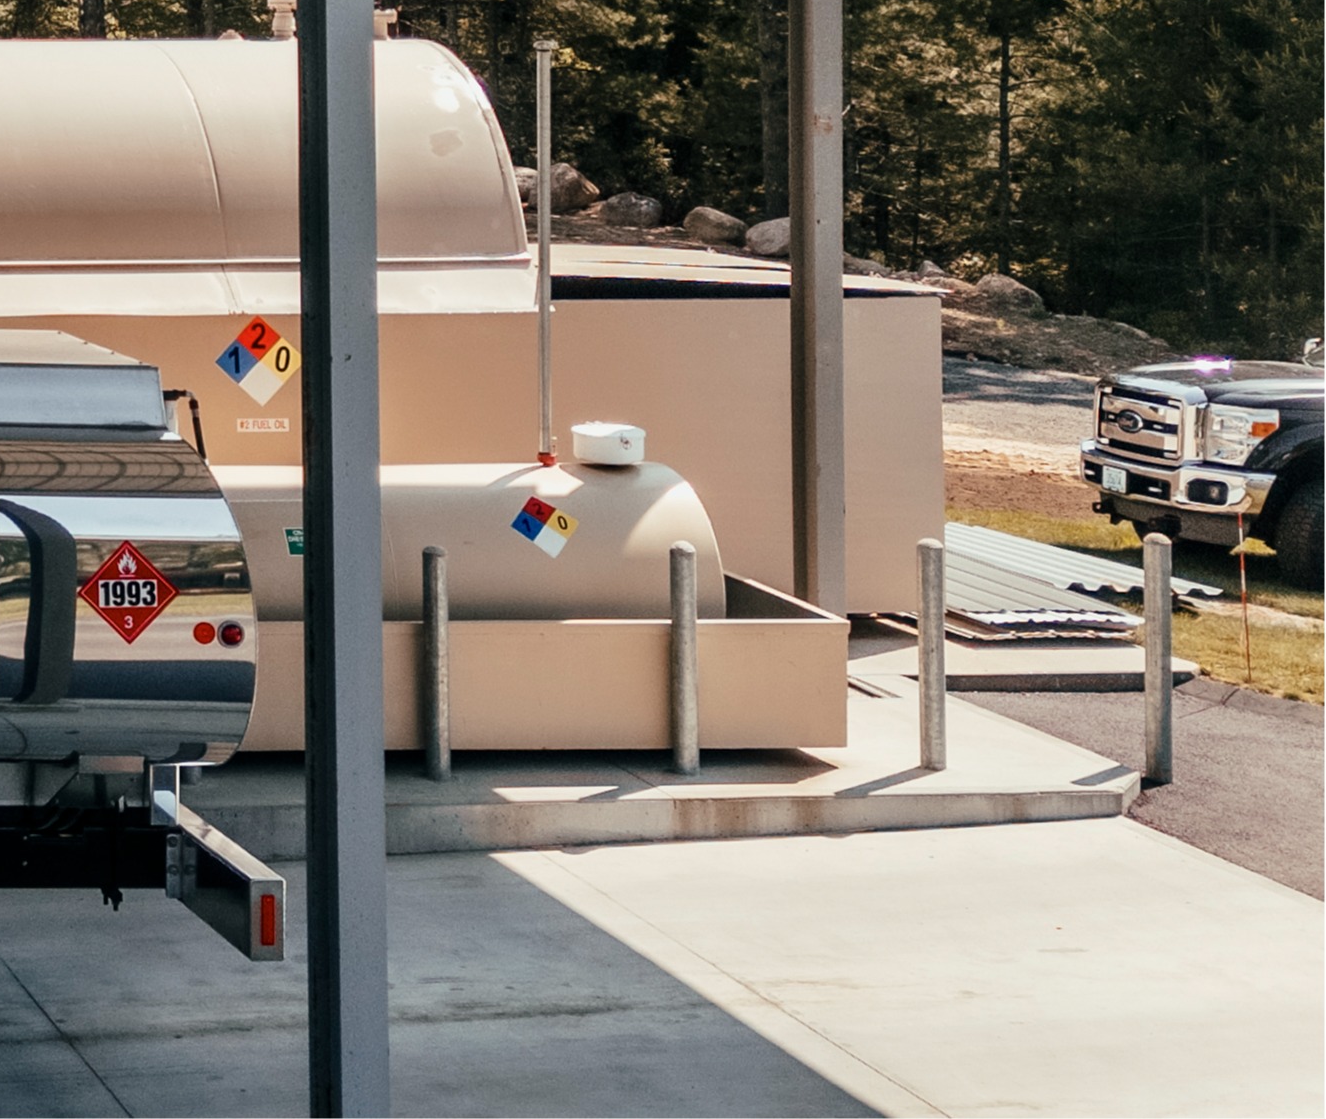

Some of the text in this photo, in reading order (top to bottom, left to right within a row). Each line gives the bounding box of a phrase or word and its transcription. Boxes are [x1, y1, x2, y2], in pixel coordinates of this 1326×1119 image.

[250, 323, 266, 349] 2
[228, 346, 291, 374] 1 0
[252, 420, 271, 430] FUEL
[274, 419, 286, 430] OIL
[532, 503, 545, 515] 2
[557, 515, 568, 530] 0
[100, 581, 156, 606] 1993
[124, 615, 133, 629] 3
